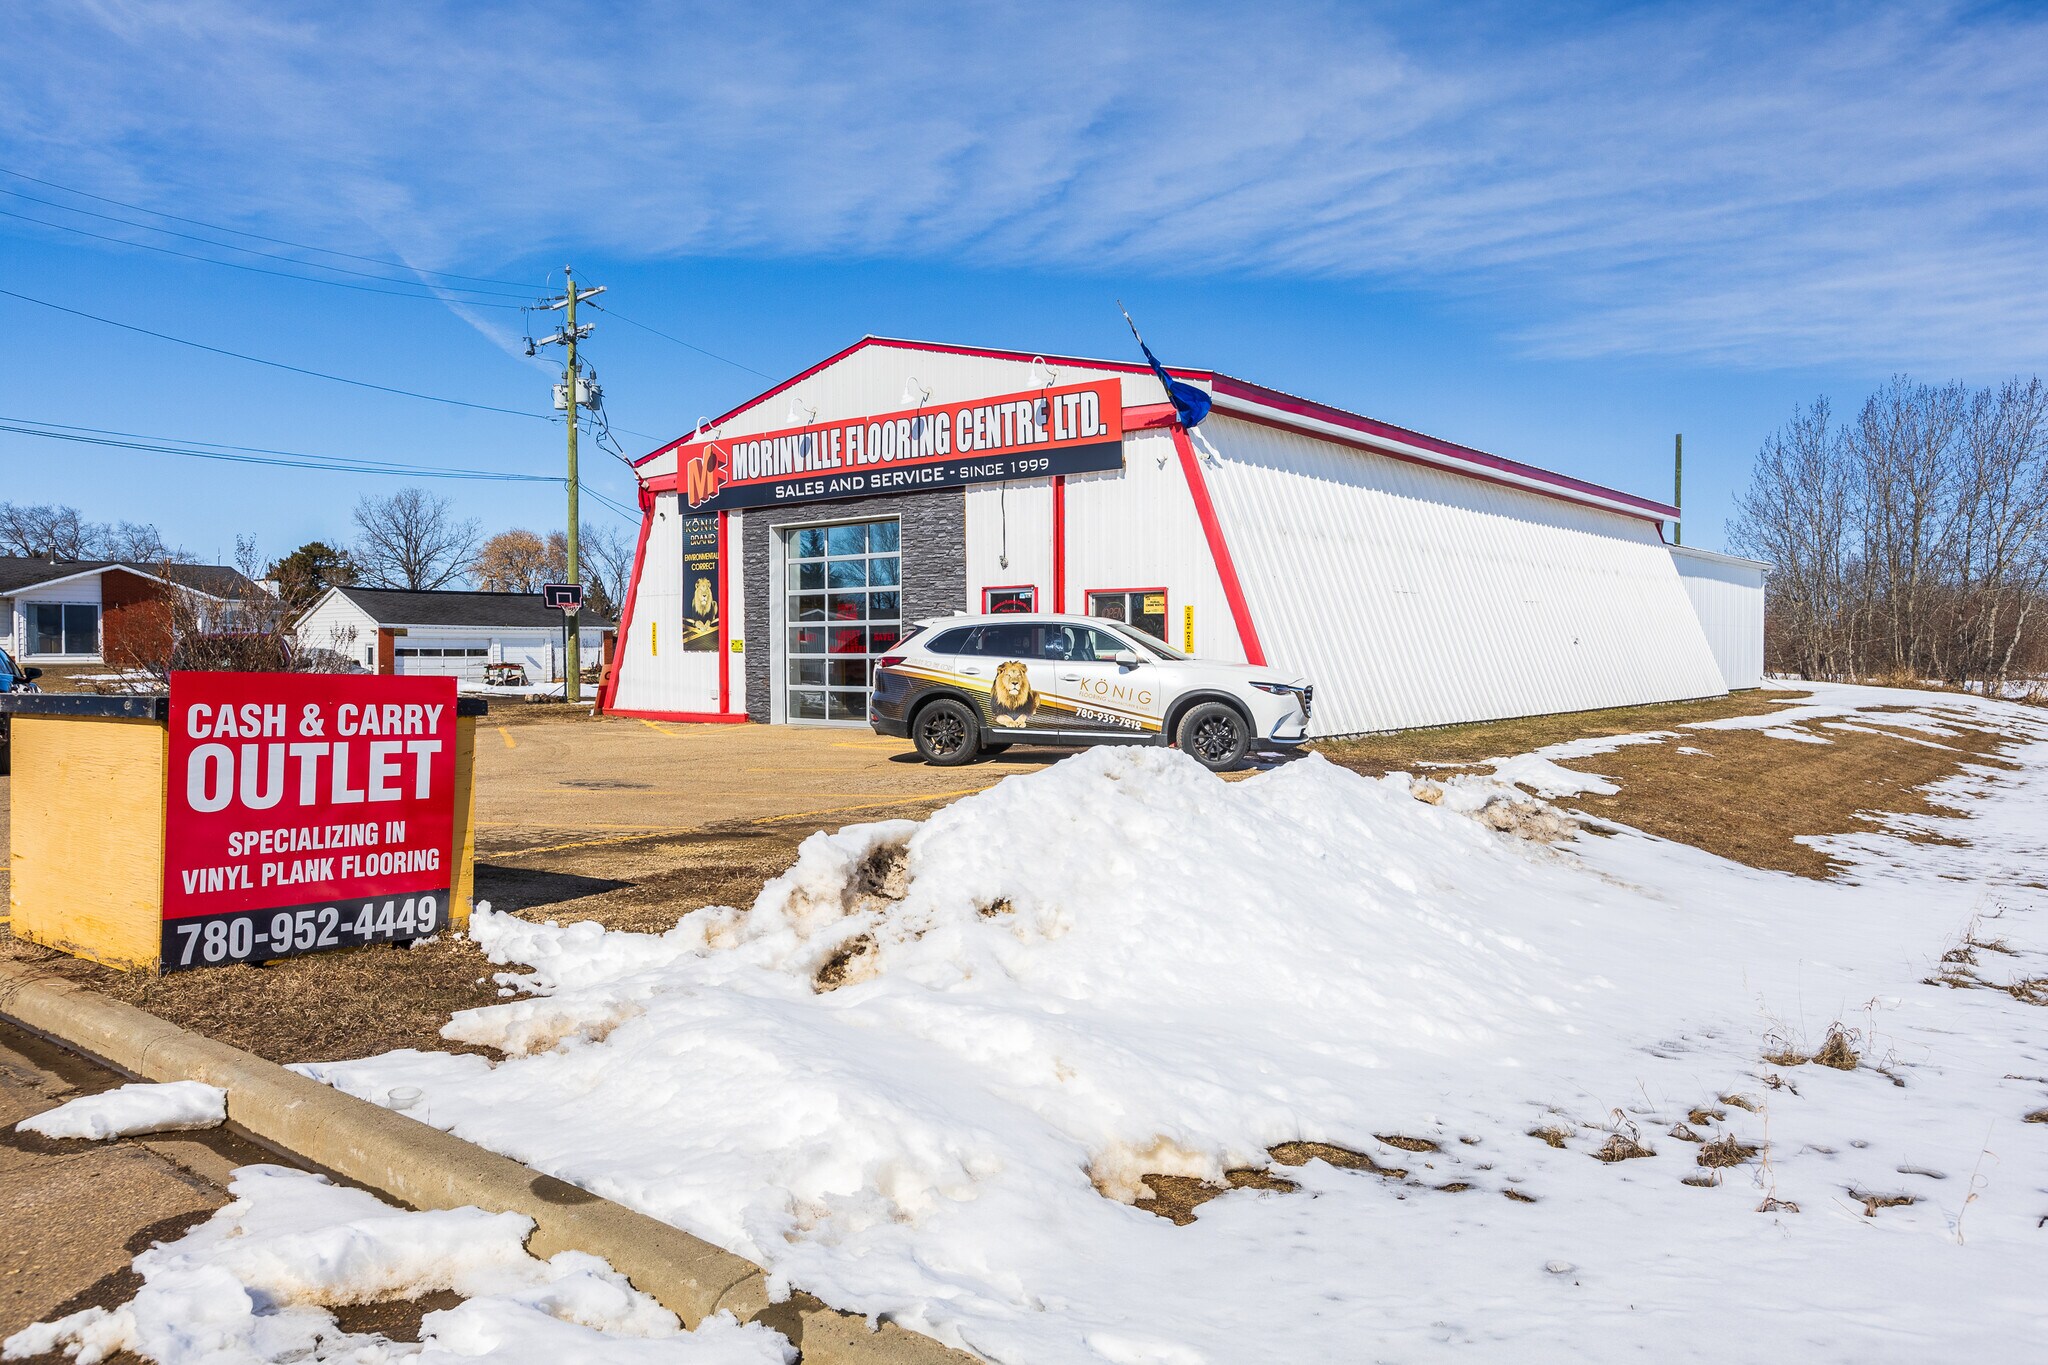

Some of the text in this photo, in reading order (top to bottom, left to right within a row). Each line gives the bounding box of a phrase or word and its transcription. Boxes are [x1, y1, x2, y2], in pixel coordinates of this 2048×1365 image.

[732, 391, 1108, 481] MORINVILLE FLOORING CENTRE LTD.
[775, 481, 824, 498] SALES
[829, 476, 865, 493] AND
[870, 467, 944, 488] SERVICE
[959, 463, 1004, 478] SINCE
[1010, 458, 1049, 473] 1999
[690, 533, 716, 545] BRAND
[691, 562, 715, 570] CORRECT
[873, 631, 895, 641] SAVE!
[1081, 677, 1151, 704] KÖNIG
[186, 703, 444, 739] CASH & CARRY
[1075, 707, 1142, 730] 780-939-7212
[186, 739, 443, 813] OUTLET
[227, 820, 406, 857] SPECIALIZING IN
[181, 848, 440, 895] VINYL PLANK FLOORING
[177, 895, 437, 966] 780-952-4449
